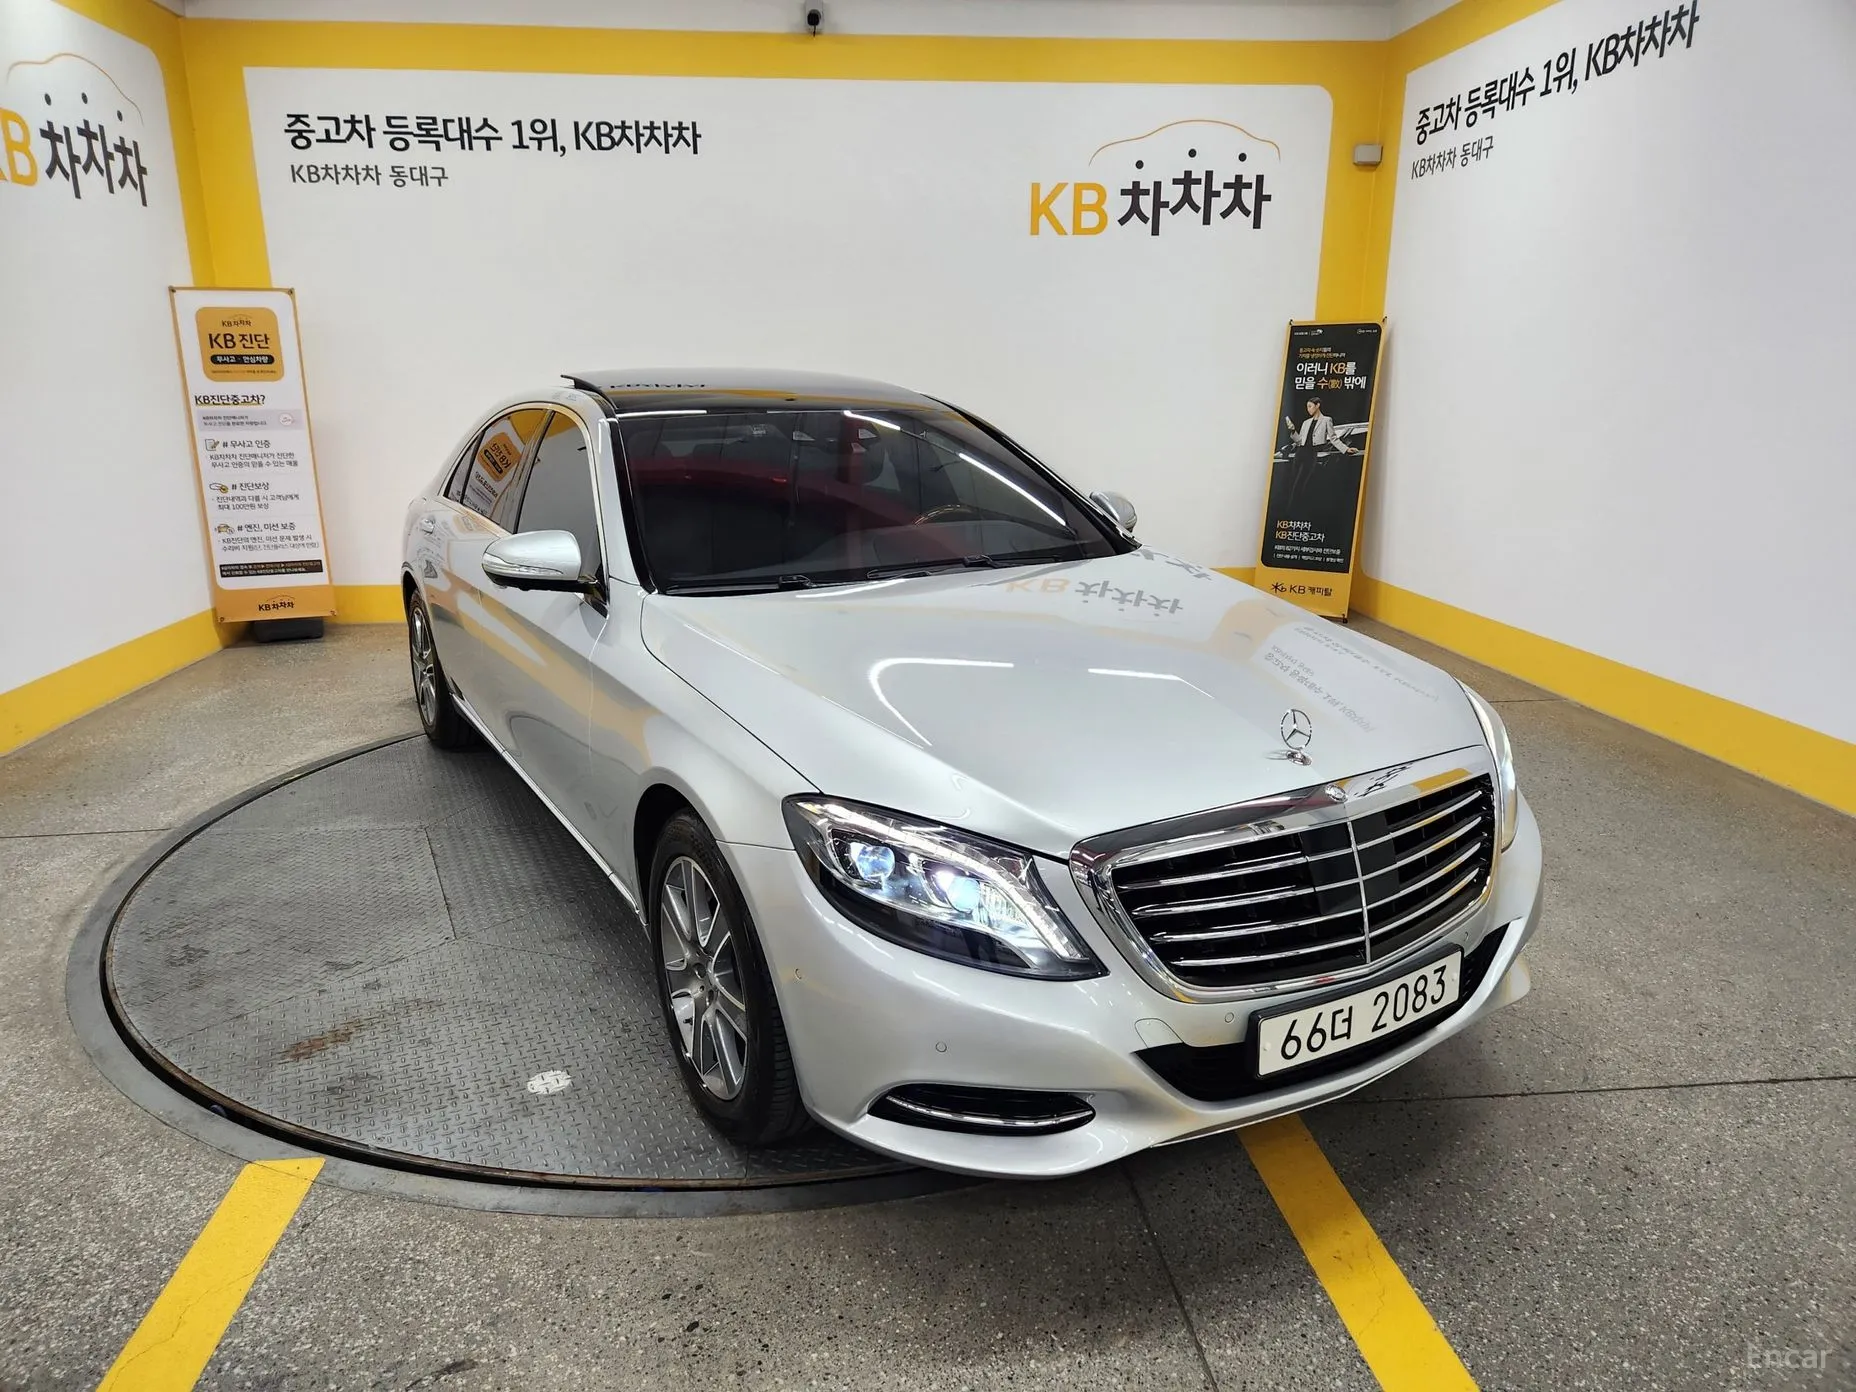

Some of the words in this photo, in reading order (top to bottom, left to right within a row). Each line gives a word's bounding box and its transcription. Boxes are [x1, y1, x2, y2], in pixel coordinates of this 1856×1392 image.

[1415, 94, 1462, 146] 중고차
[1464, 66, 1536, 128] 등록대수
[1539, 47, 1579, 95] 1위,
[1584, 0, 1700, 81] KB차차차
[284, 113, 376, 151] 중고차
[383, 115, 503, 152] 등록대수
[511, 118, 566, 158] 1위,
[573, 119, 702, 155] KB차차차
[0, 107, 38, 187] B
[39, 92, 148, 207] 차차차
[1411, 147, 1457, 180] KB차차차
[1460, 135, 1494, 167] 동대구
[290, 163, 382, 186] KB차차차
[389, 165, 449, 188] 동대구
[1030, 182, 1108, 236] KB
[1117, 147, 1272, 237] 차차차
[222, 319, 233, 327] KB
[208, 333, 236, 349] KB
[239, 333, 270, 349] 진단
[1296, 361, 1328, 375] 이러니
[1329, 361, 1356, 375] KB를
[1295, 376, 1316, 390] 믿을
[1344, 376, 1367, 390] 밖에
[194, 394, 266, 405] KB진단중고차?
[239, 482, 269, 491] 진단보상
[1277, 520, 1311, 531] KB차차차
[1275, 530, 1325, 542] KB진단중고차
[1289, 585, 1306, 594] KB
[1308, 586, 1332, 596] 캐피탈
[258, 603, 271, 611] KB
[1280, 1005, 1353, 1060] 66더
[1371, 964, 1448, 1033] 2083
